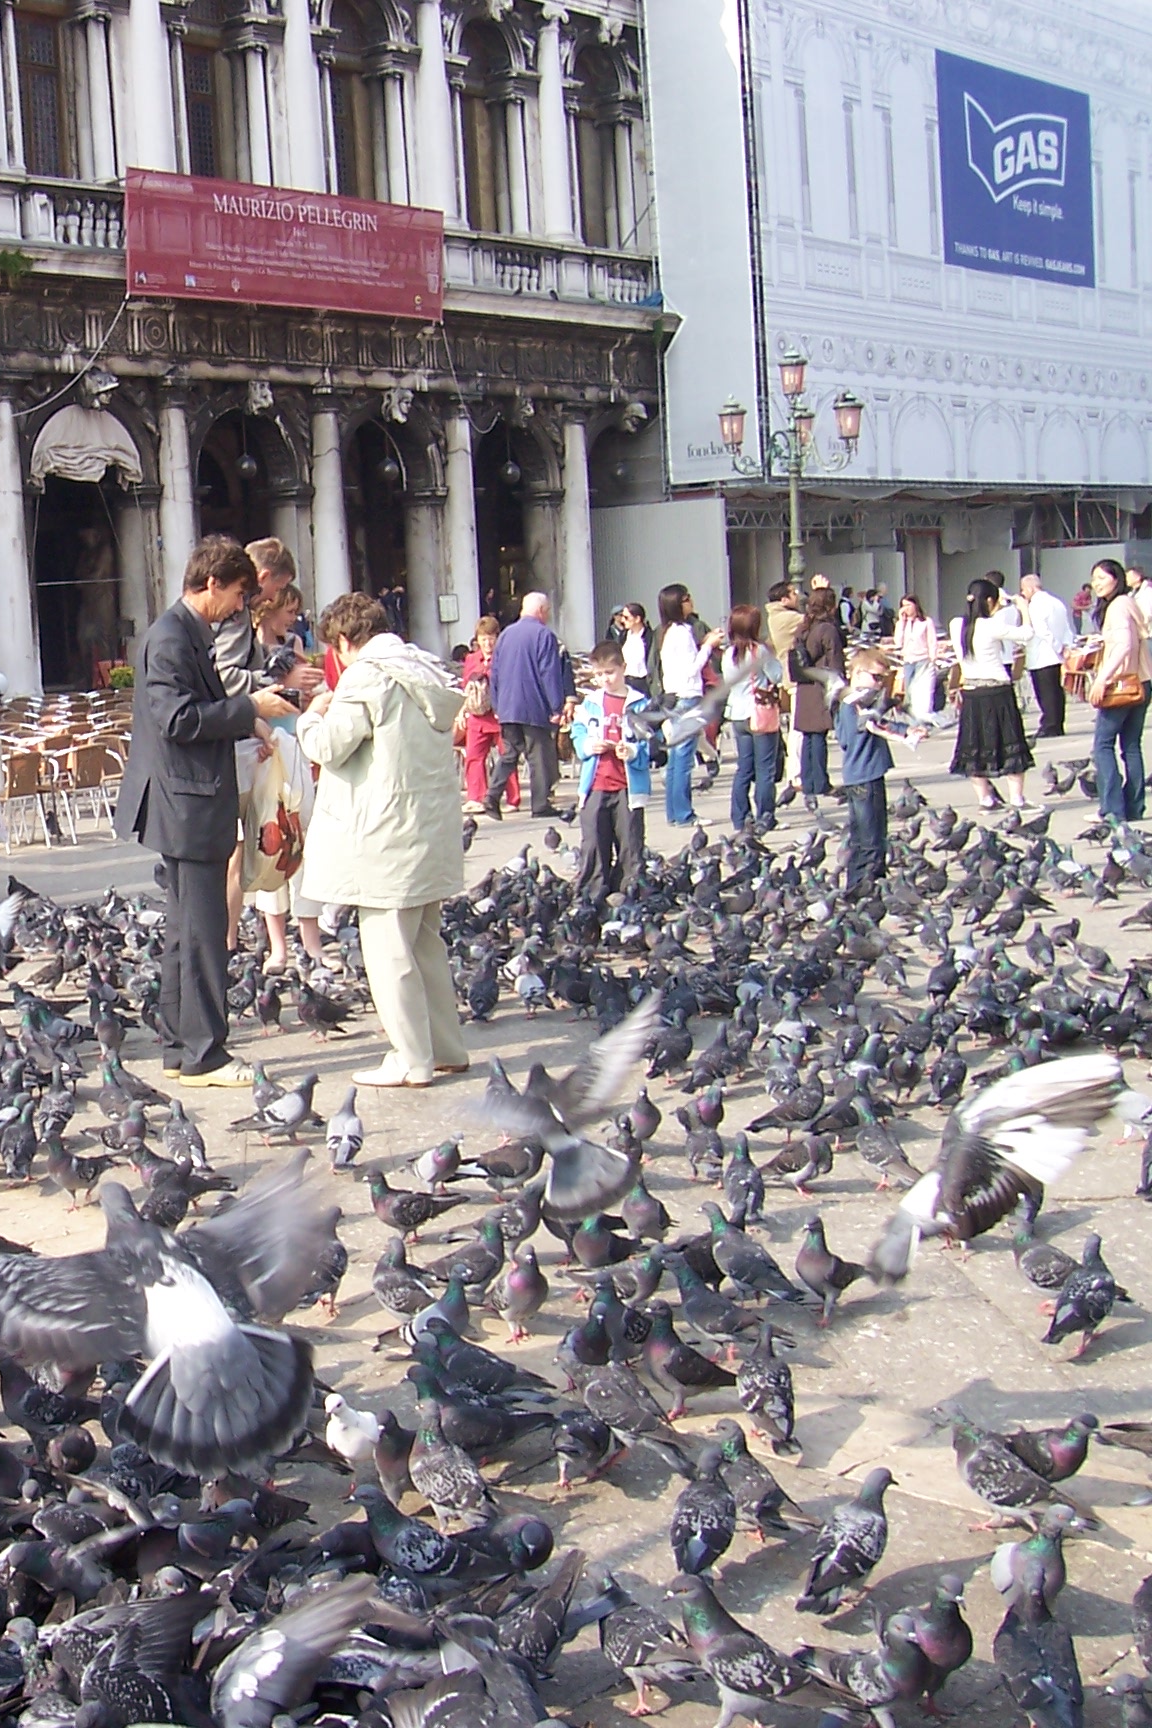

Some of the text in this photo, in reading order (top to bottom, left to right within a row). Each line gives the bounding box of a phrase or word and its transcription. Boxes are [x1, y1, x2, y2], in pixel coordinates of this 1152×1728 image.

[993, 130, 1058, 185] GAS
[212, 193, 378, 232] MAURIZIO PELLEGRIN
[1012, 194, 1032, 217] Keep
[954, 241, 979, 258] THANKS
[1002, 250, 1013, 263] ART
